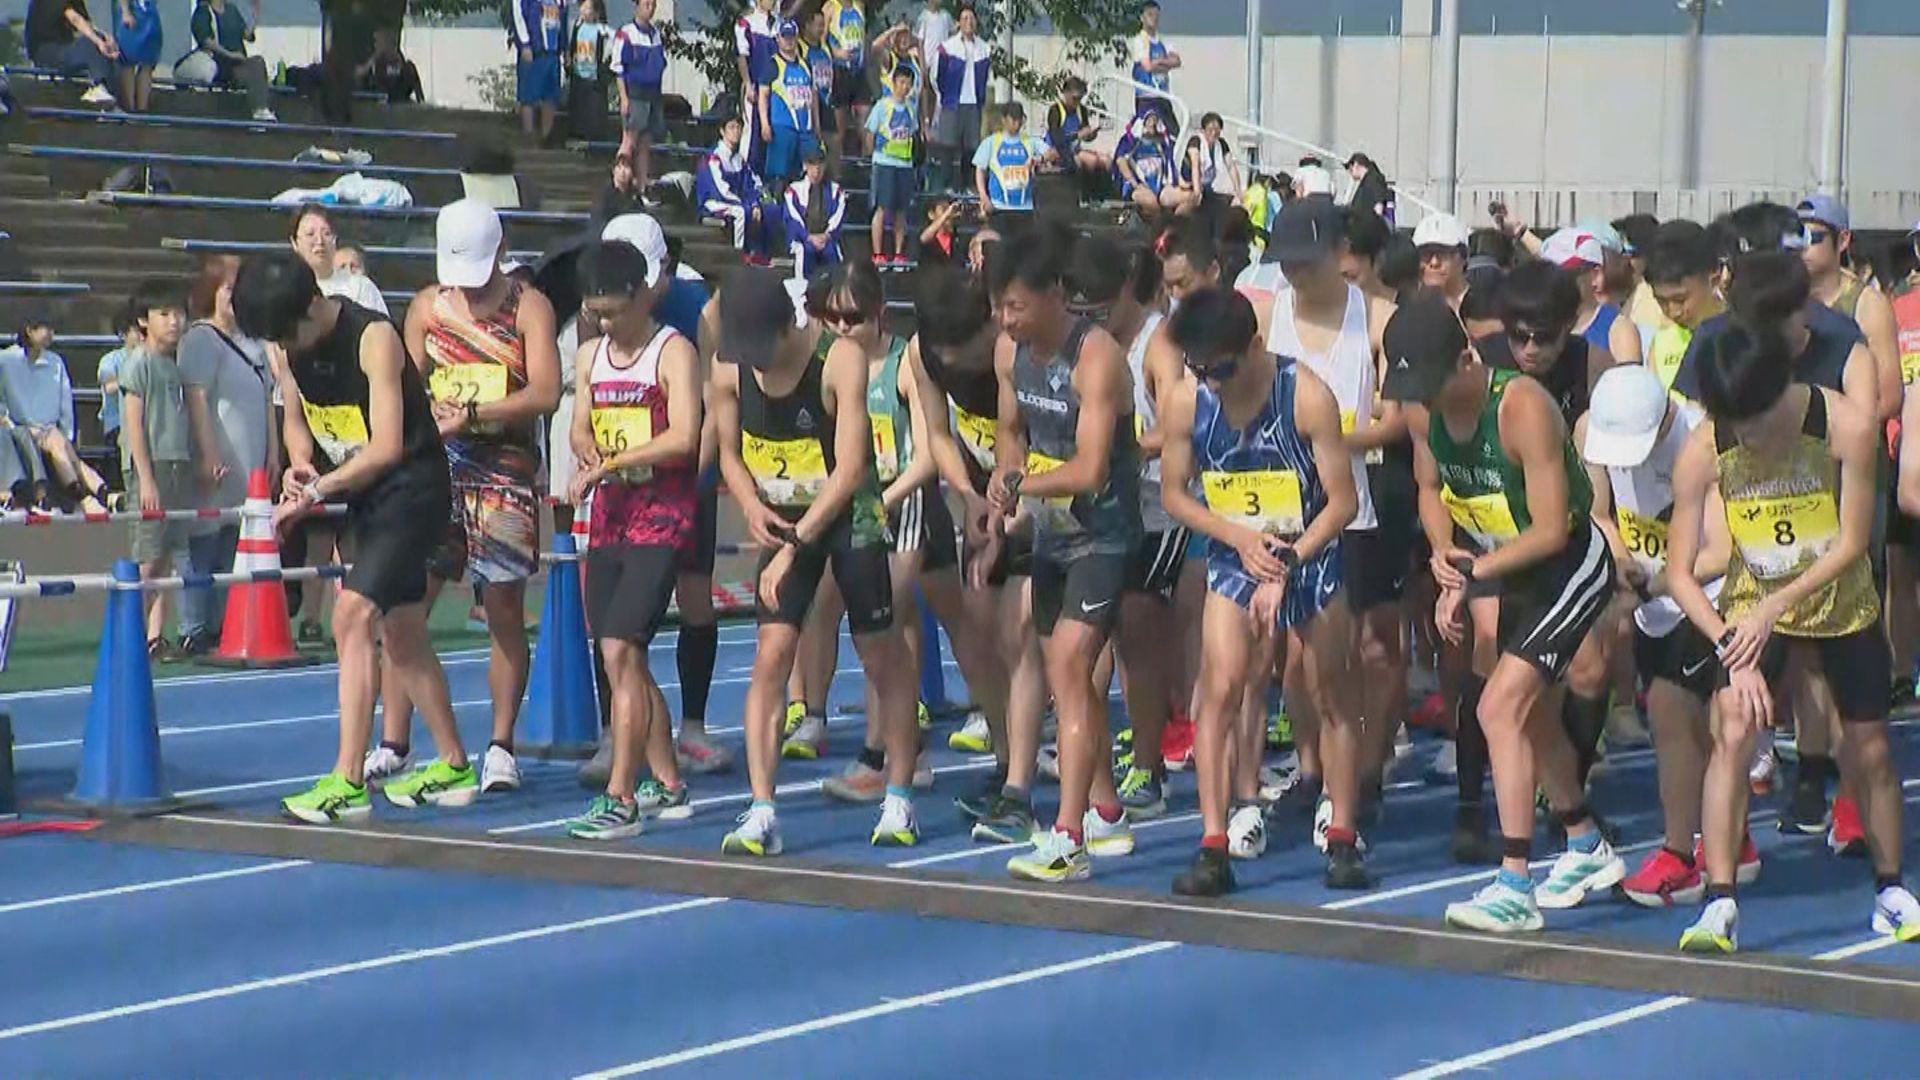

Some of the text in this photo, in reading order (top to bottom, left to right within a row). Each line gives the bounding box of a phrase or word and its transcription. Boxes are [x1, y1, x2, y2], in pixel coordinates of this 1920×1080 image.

[602, 428, 628, 453] 16
[773, 457, 791, 480] 2
[1244, 491, 1260, 516] 3
[1773, 520, 1796, 546] 8
